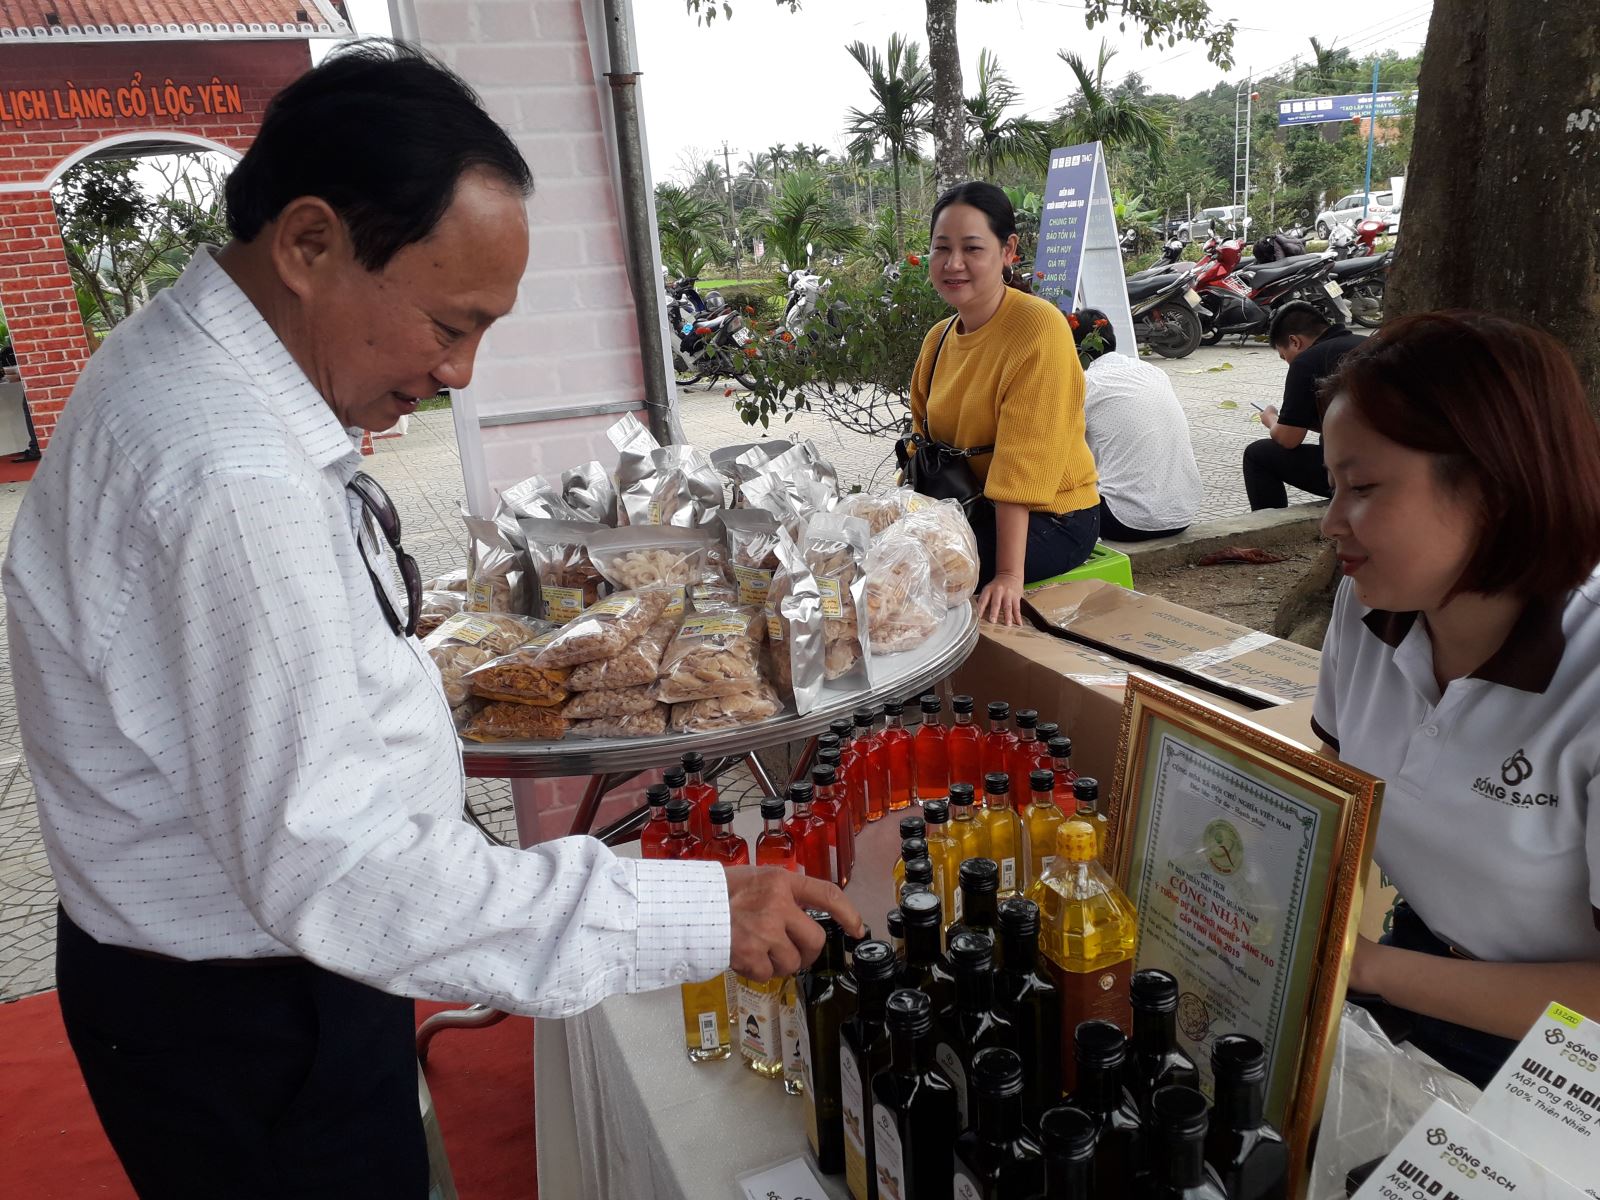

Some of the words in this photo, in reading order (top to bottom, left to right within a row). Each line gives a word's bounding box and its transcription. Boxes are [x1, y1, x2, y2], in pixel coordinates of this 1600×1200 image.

[53, 80, 114, 120] LÀNG
[117, 71, 147, 118] CỔ
[151, 78, 194, 121] LỘC
[198, 76, 243, 114] YÊN
[1276, 818, 1292, 831] NAM
[1169, 875, 1207, 908] CÔNG
[1210, 900, 1252, 937] NHẬN
[1223, 942, 1240, 959] 2019
[1521, 1057, 1568, 1090] WILD
[1560, 1048, 1597, 1073] FOOD
[1505, 1083, 1534, 1103] 100%
[1534, 1099, 1560, 1119] Thiên
[1561, 1116, 1592, 1137] Nhiên
[1537, 1085, 1562, 1104] Ong
[1563, 1099, 1592, 1123] Rừng
[1396, 1159, 1443, 1197] WILD
[1440, 1151, 1478, 1180] FOOD
[1481, 1165, 1517, 1192] SẠCH
